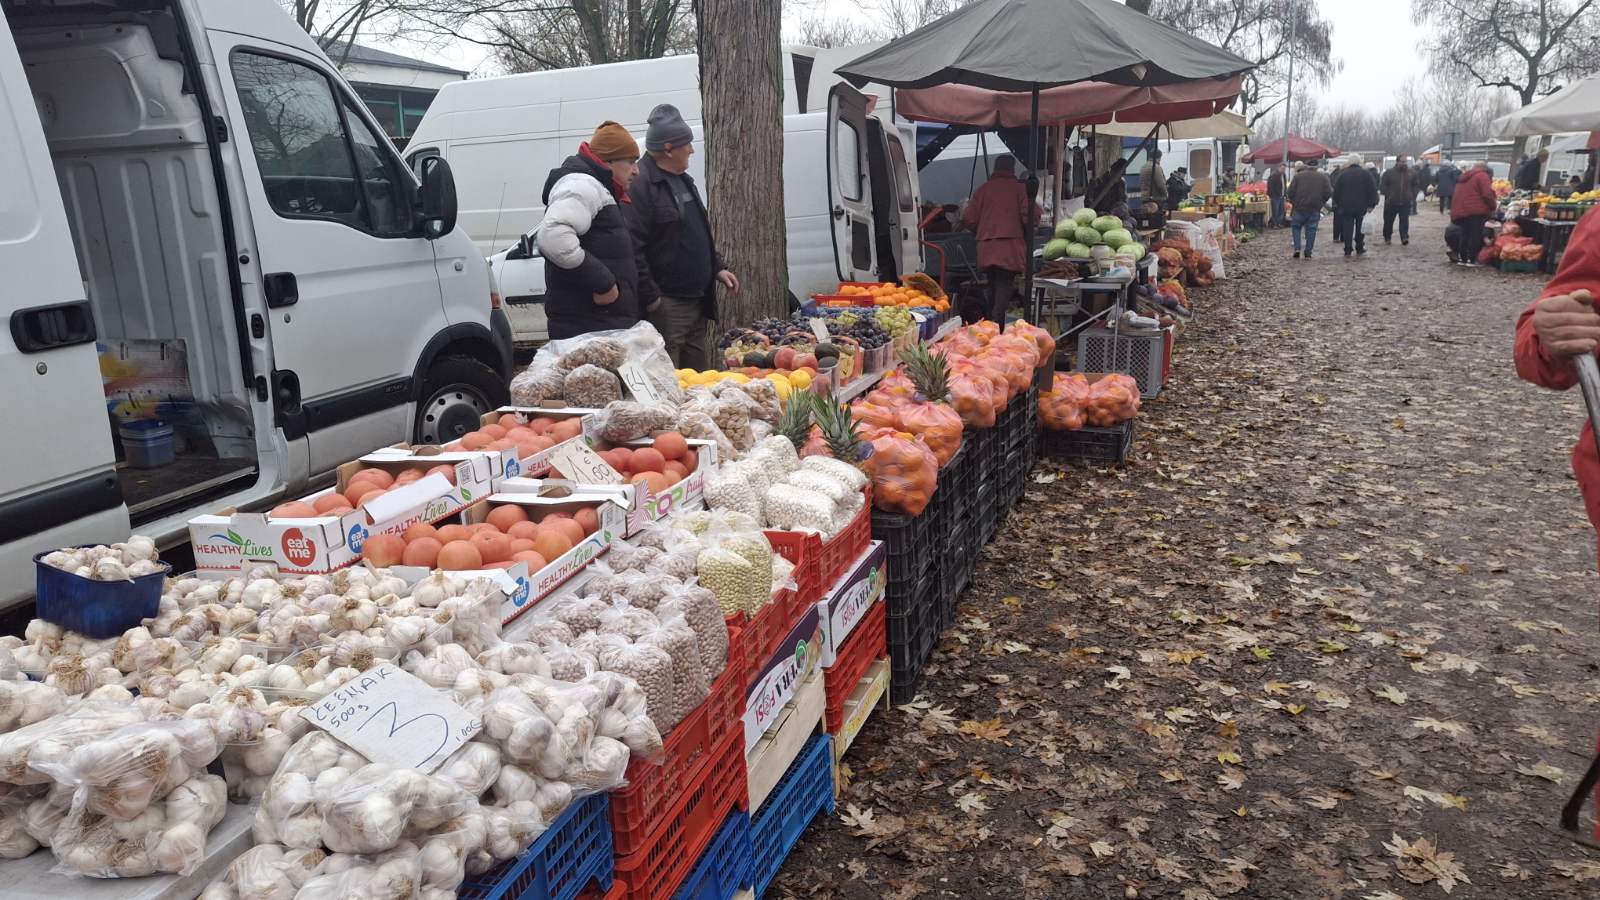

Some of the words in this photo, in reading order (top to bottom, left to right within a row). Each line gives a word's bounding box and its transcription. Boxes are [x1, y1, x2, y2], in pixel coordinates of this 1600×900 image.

[422, 501, 448, 523] Lives
[287, 538, 309, 549] eat
[351, 530, 365, 541] eat
[197, 544, 241, 555] HEALTHY
[241, 539, 273, 556] Lives
[289, 549, 310, 559] me
[538, 561, 573, 593] HEALTHY
[571, 547, 593, 569] Lives
[357, 701, 449, 769] 3
